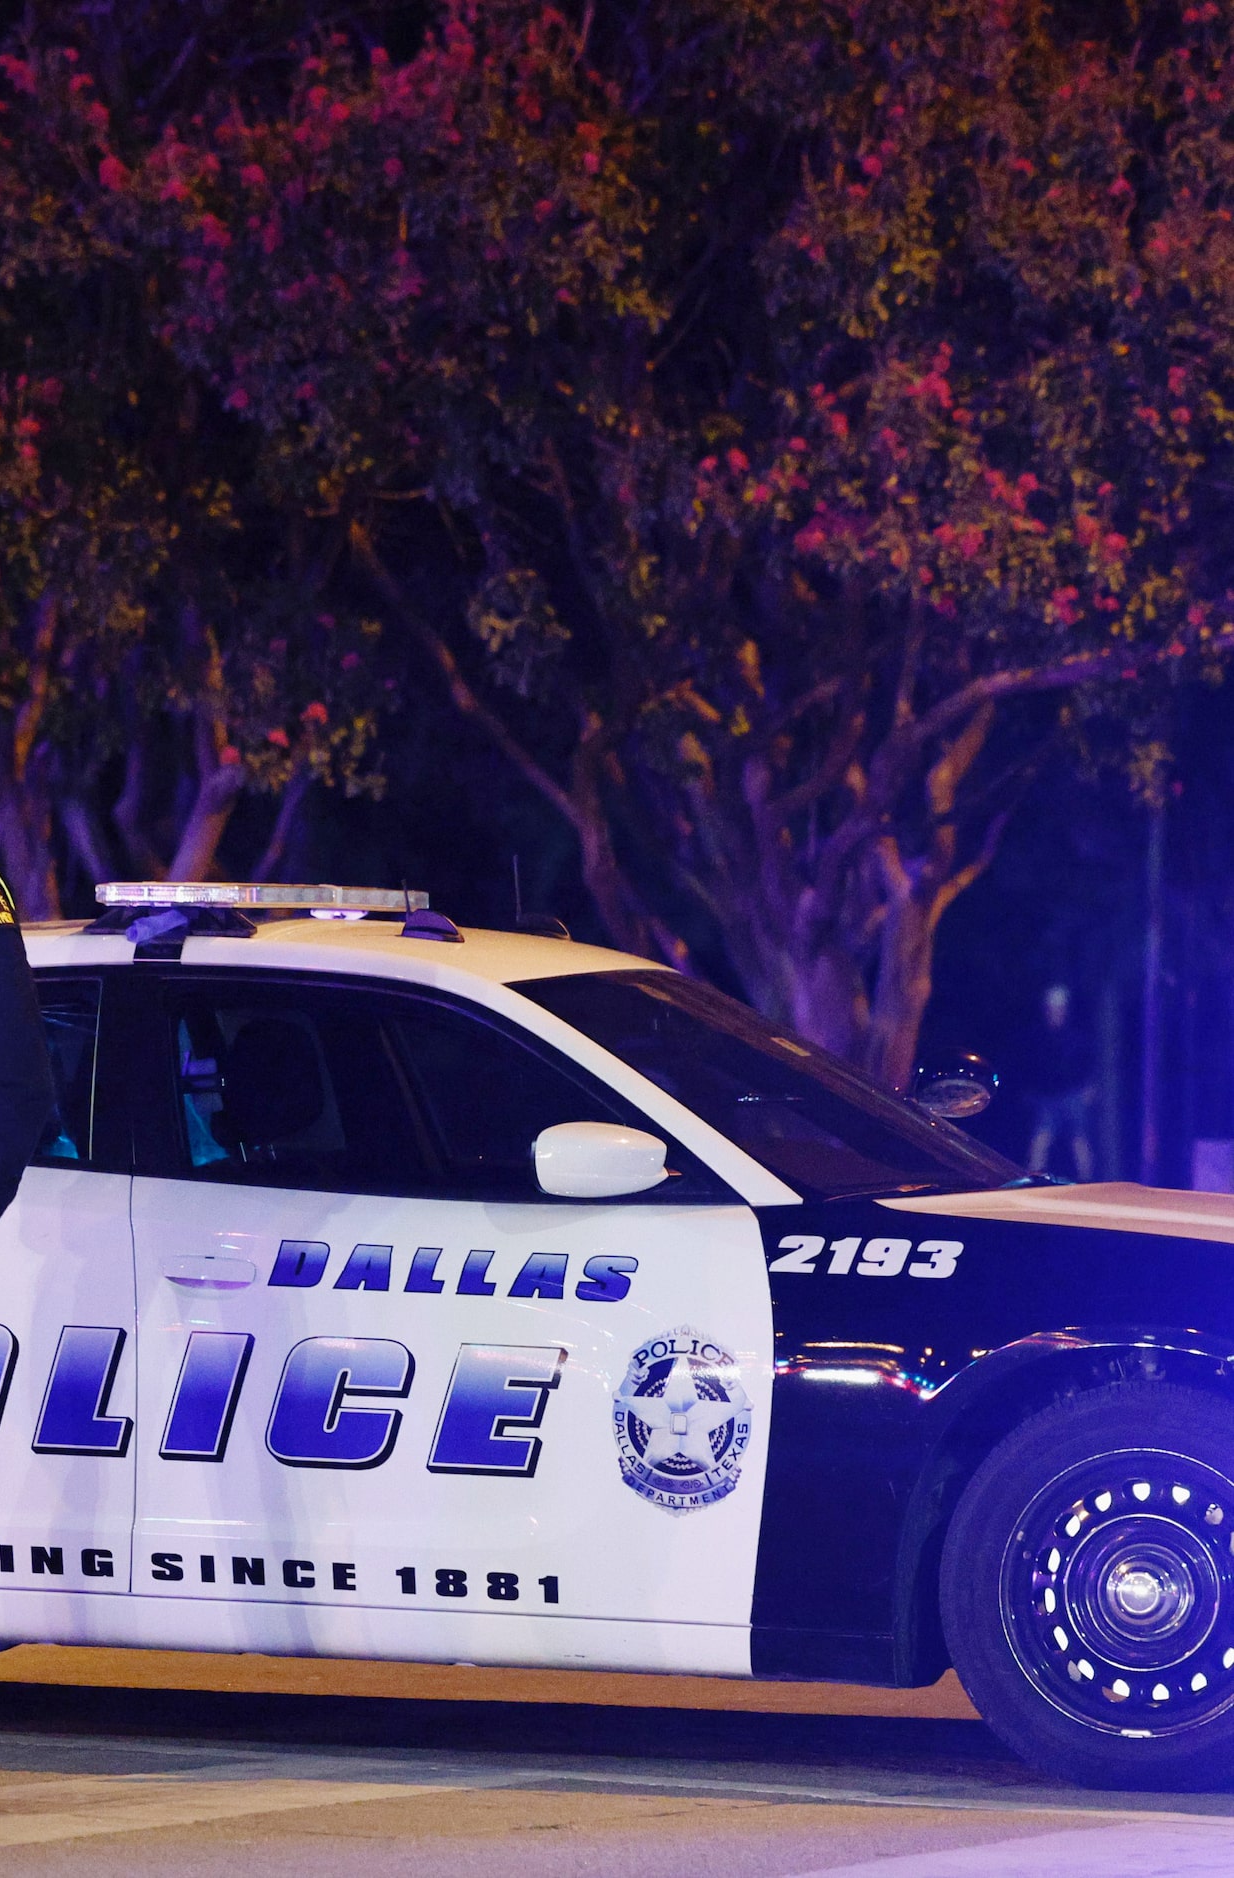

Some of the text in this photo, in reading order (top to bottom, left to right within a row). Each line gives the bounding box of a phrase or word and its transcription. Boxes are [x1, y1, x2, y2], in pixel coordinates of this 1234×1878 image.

[267, 1239, 640, 1302] DALLAS
[768, 1234, 965, 1279] 2193
[632, 1339, 735, 1369] POLICE
[614, 1411, 749, 1479] DALLAS TEXAS
[625, 1474, 732, 1506] DEPARTMENT
[150, 1552, 357, 1591] SINCE
[395, 1566, 560, 1604] 1881
